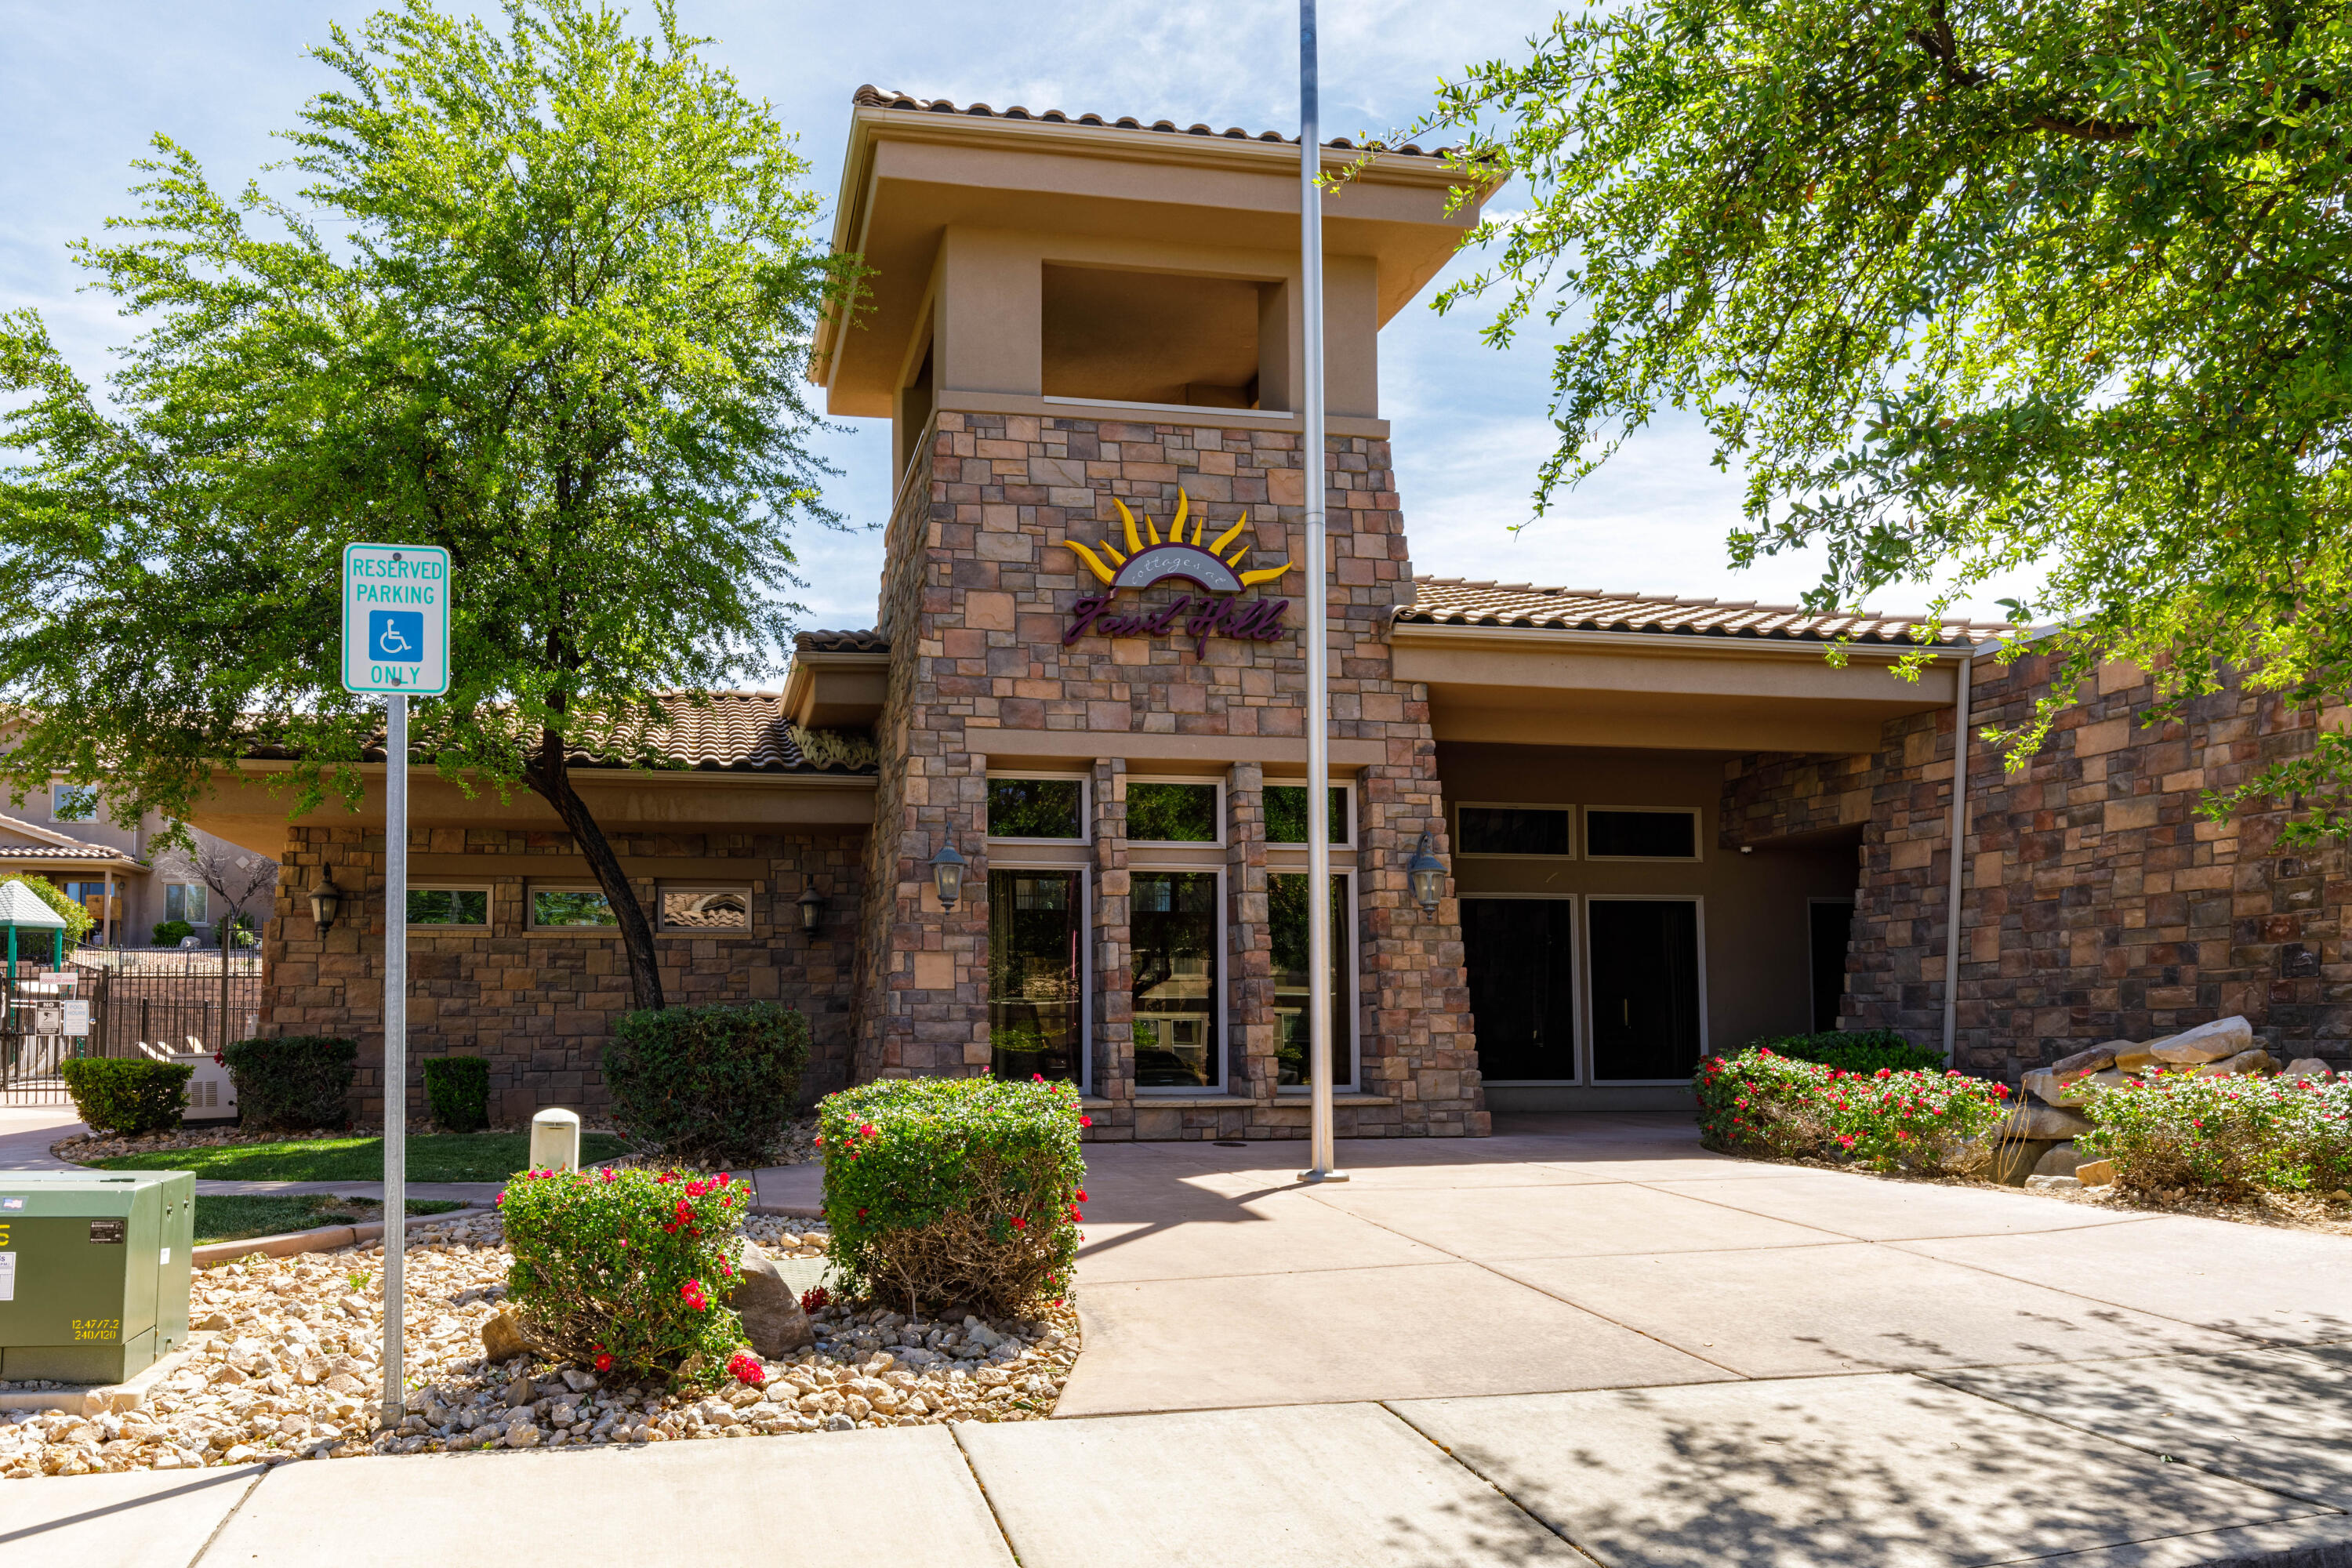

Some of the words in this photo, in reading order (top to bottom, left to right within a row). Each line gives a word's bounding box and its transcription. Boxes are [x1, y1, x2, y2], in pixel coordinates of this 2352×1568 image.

[353, 558, 442, 580] RESERVED
[357, 584, 434, 604] PARKING
[1187, 594, 1290, 661] Hills
[371, 665, 420, 684] ONLY
[72, 1319, 120, 1330] 12.47/7.2
[74, 1330, 117, 1340] 240/120
